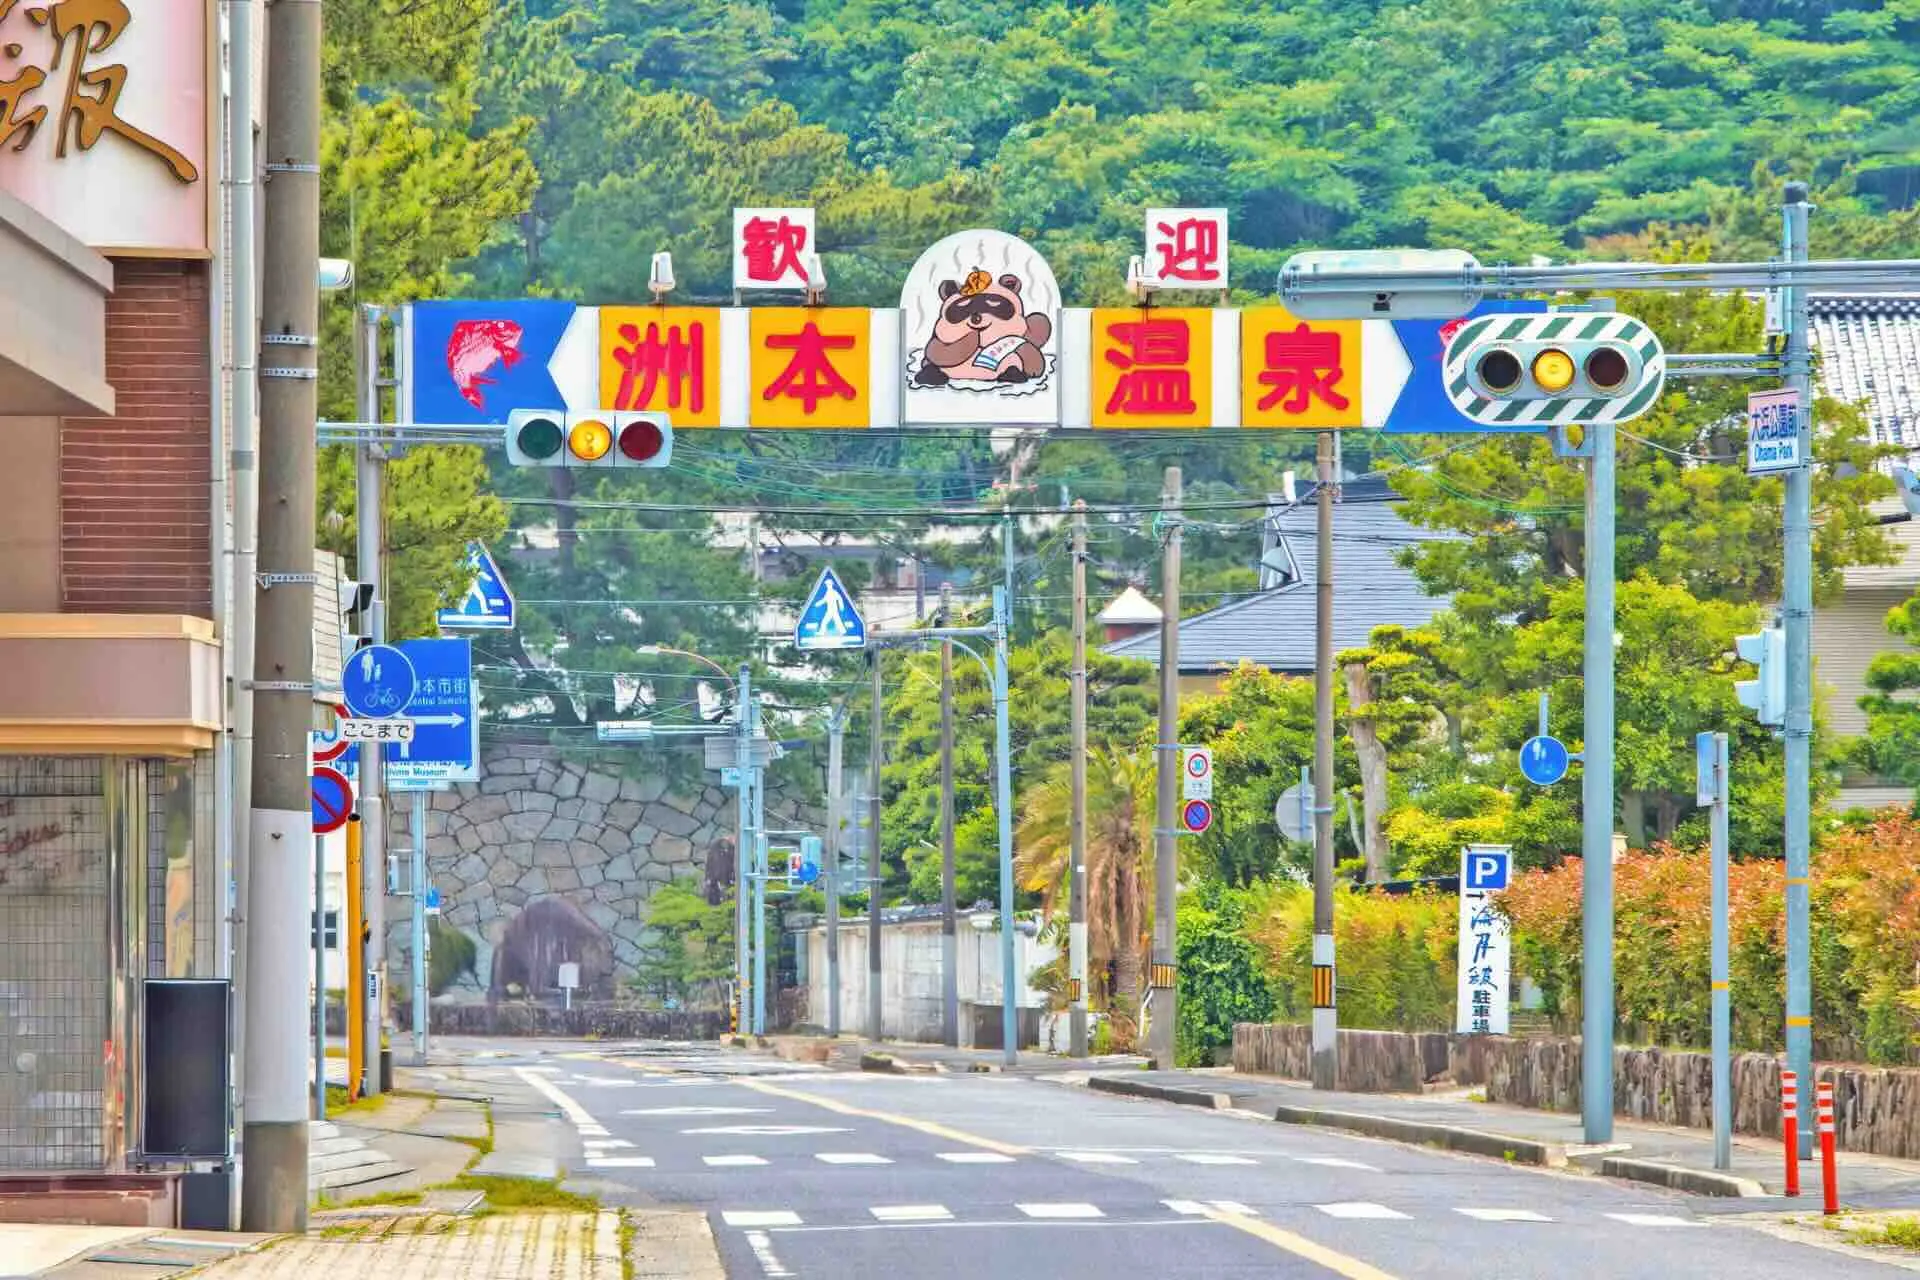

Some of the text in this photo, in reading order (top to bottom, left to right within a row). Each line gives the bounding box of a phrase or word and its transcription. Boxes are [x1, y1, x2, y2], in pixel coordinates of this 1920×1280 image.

[613, 319, 1350, 415] 洲本 温泉
[343, 722, 410, 739] ここまで
[1475, 857, 1498, 886] P
